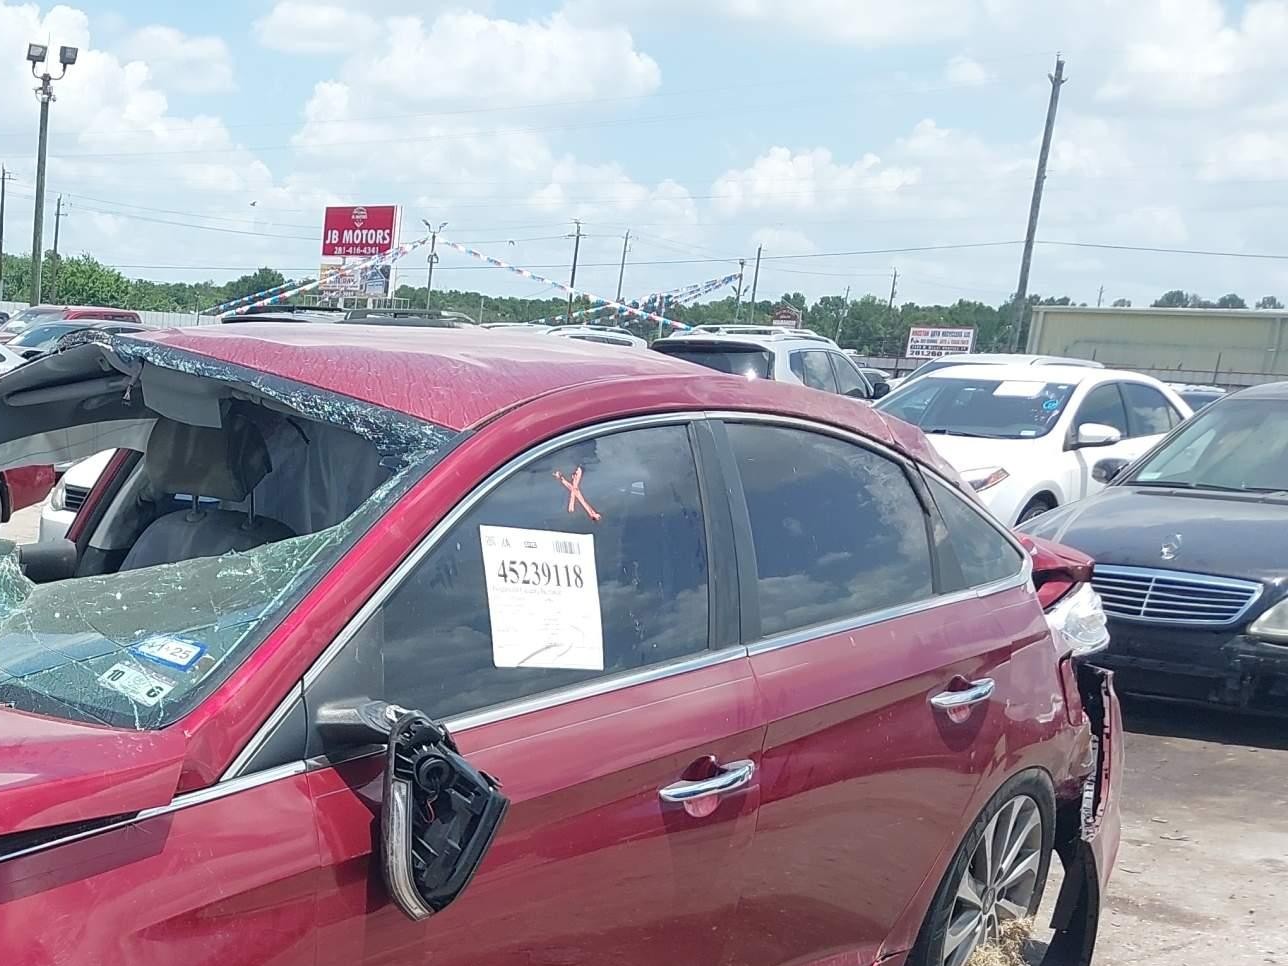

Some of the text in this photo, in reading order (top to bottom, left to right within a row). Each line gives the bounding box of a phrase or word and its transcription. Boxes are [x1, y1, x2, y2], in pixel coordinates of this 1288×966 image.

[326, 229, 390, 244] JB MOTORS
[497, 559, 584, 589] 45239118
[107, 669, 125, 682] 10
